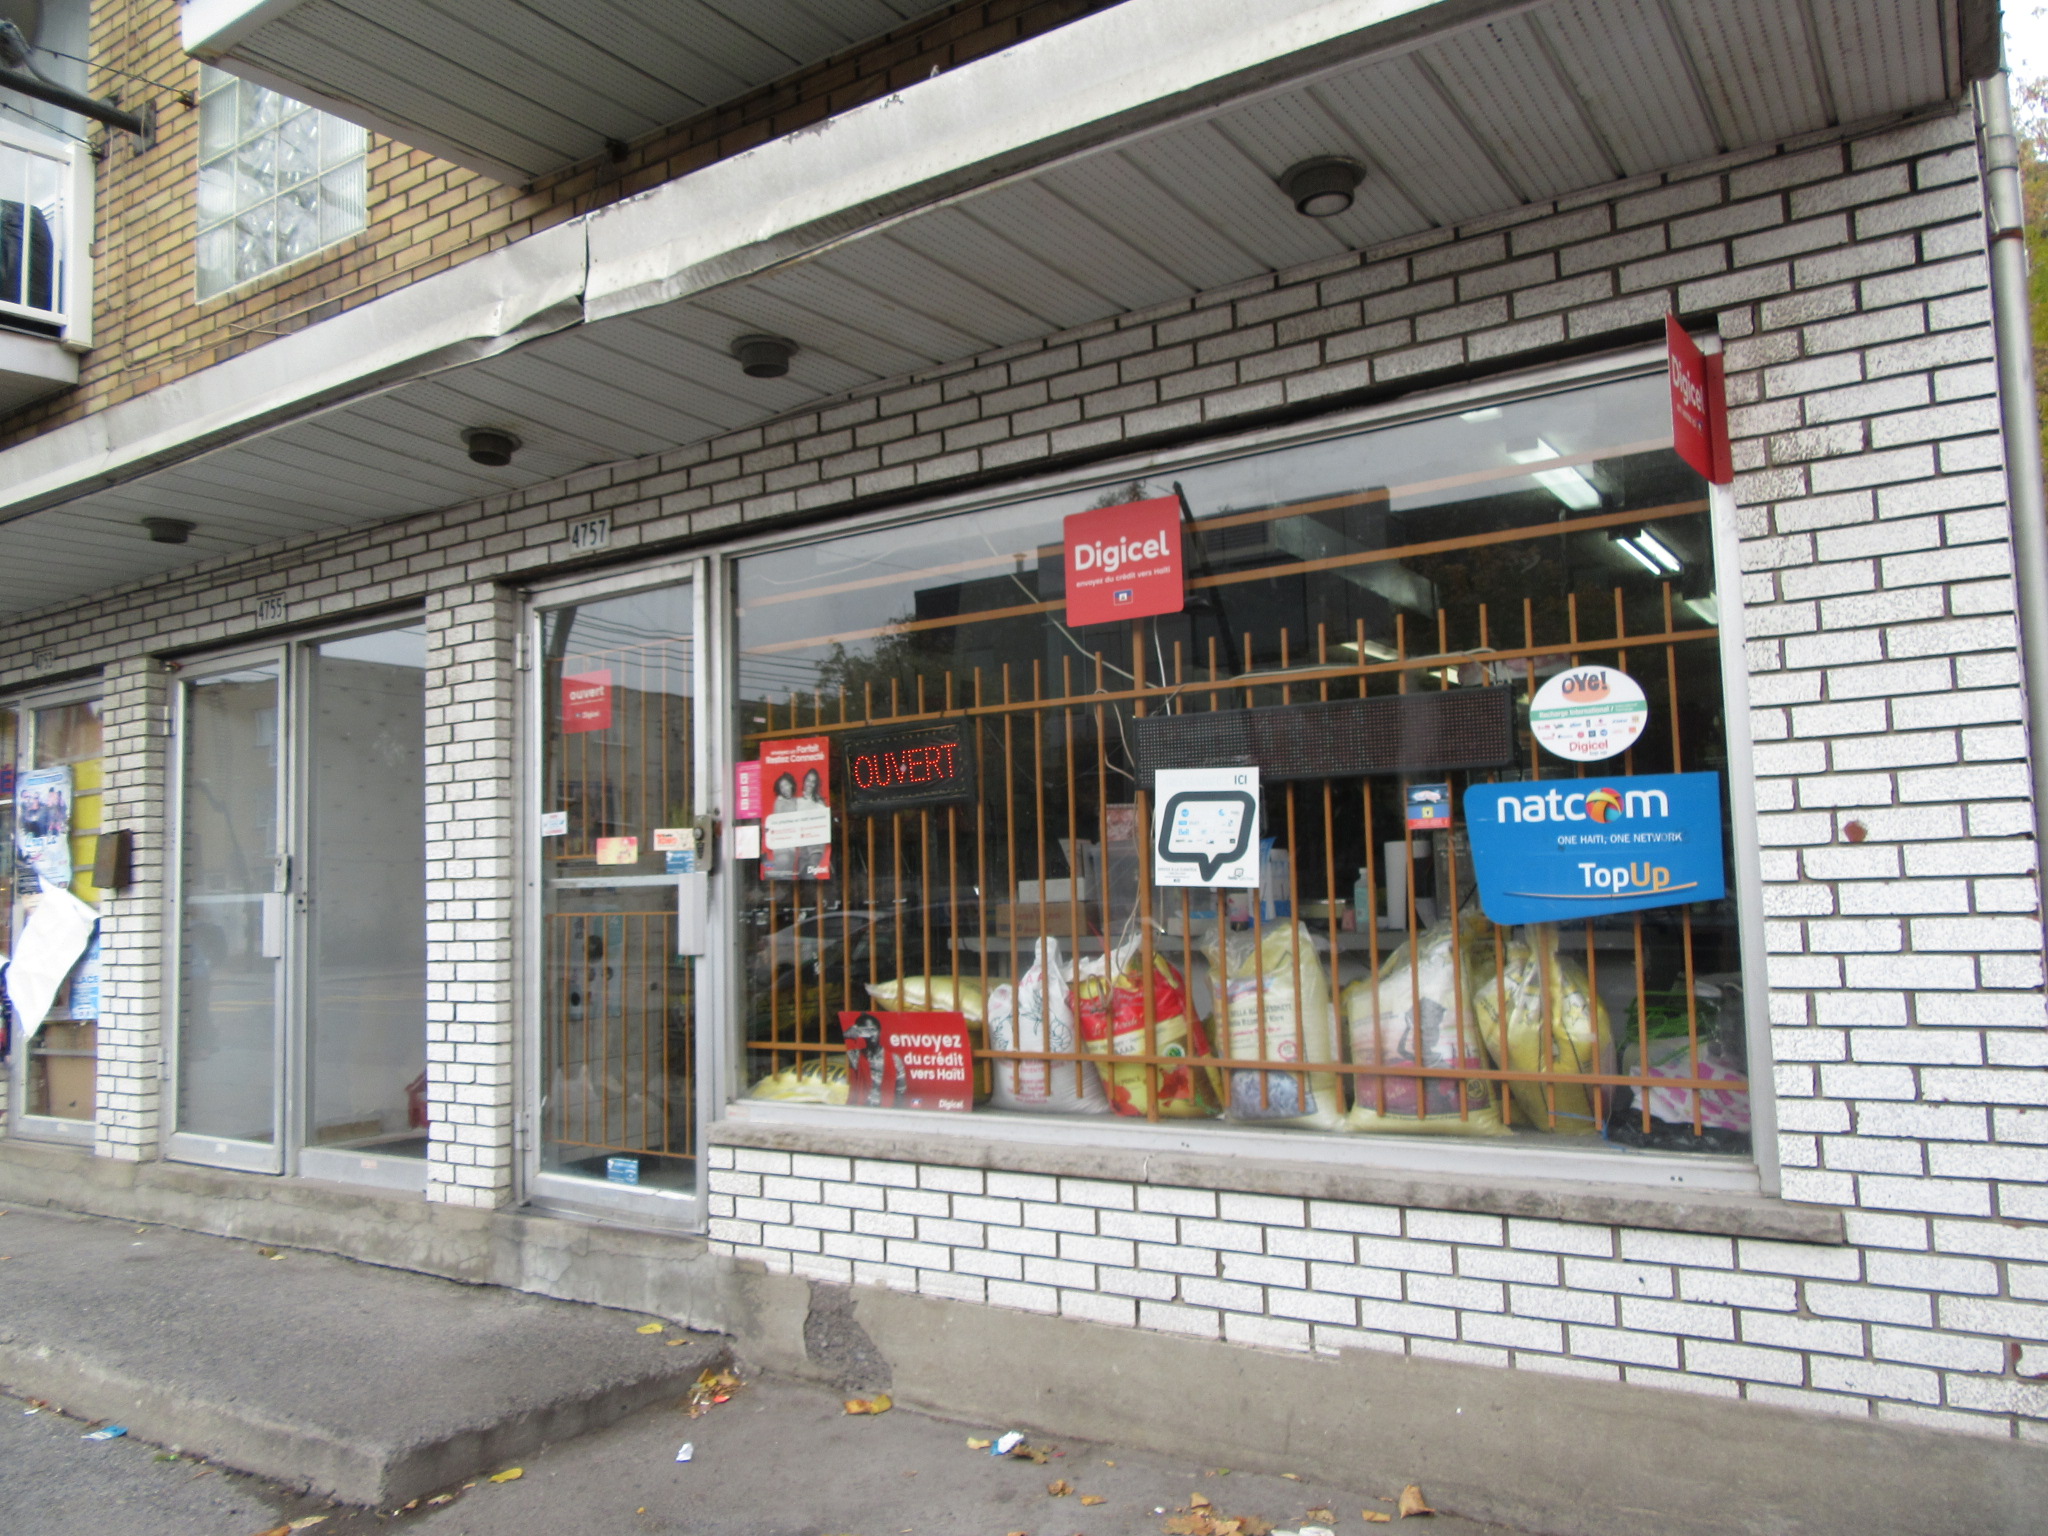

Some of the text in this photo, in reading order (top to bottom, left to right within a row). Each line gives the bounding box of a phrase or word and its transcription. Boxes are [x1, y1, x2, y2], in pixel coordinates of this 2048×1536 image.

[1671, 354, 1705, 414] Digicel
[572, 519, 606, 548] 4757
[1074, 530, 1170, 573] Digicel
[1076, 578, 1103, 588] envoyez
[1115, 572, 1136, 582] crédit
[1137, 569, 1152, 578] vers
[258, 597, 282, 621] 4755
[569, 685, 605, 701] ouvert
[1569, 739, 1609, 753] Digicel
[853, 742, 959, 790] OUVERT
[1234, 774, 1248, 785] ICI
[1557, 835, 1577, 845] ONE
[1610, 833, 1630, 844] ONE
[1633, 832, 1683, 843] NETWORK
[806, 865, 829, 875] Digicel
[889, 1033, 962, 1054] envoyez
[903, 1051, 964, 1067] du crédit
[909, 1068, 936, 1080] vers
[938, 1098, 964, 1110] Digicel
